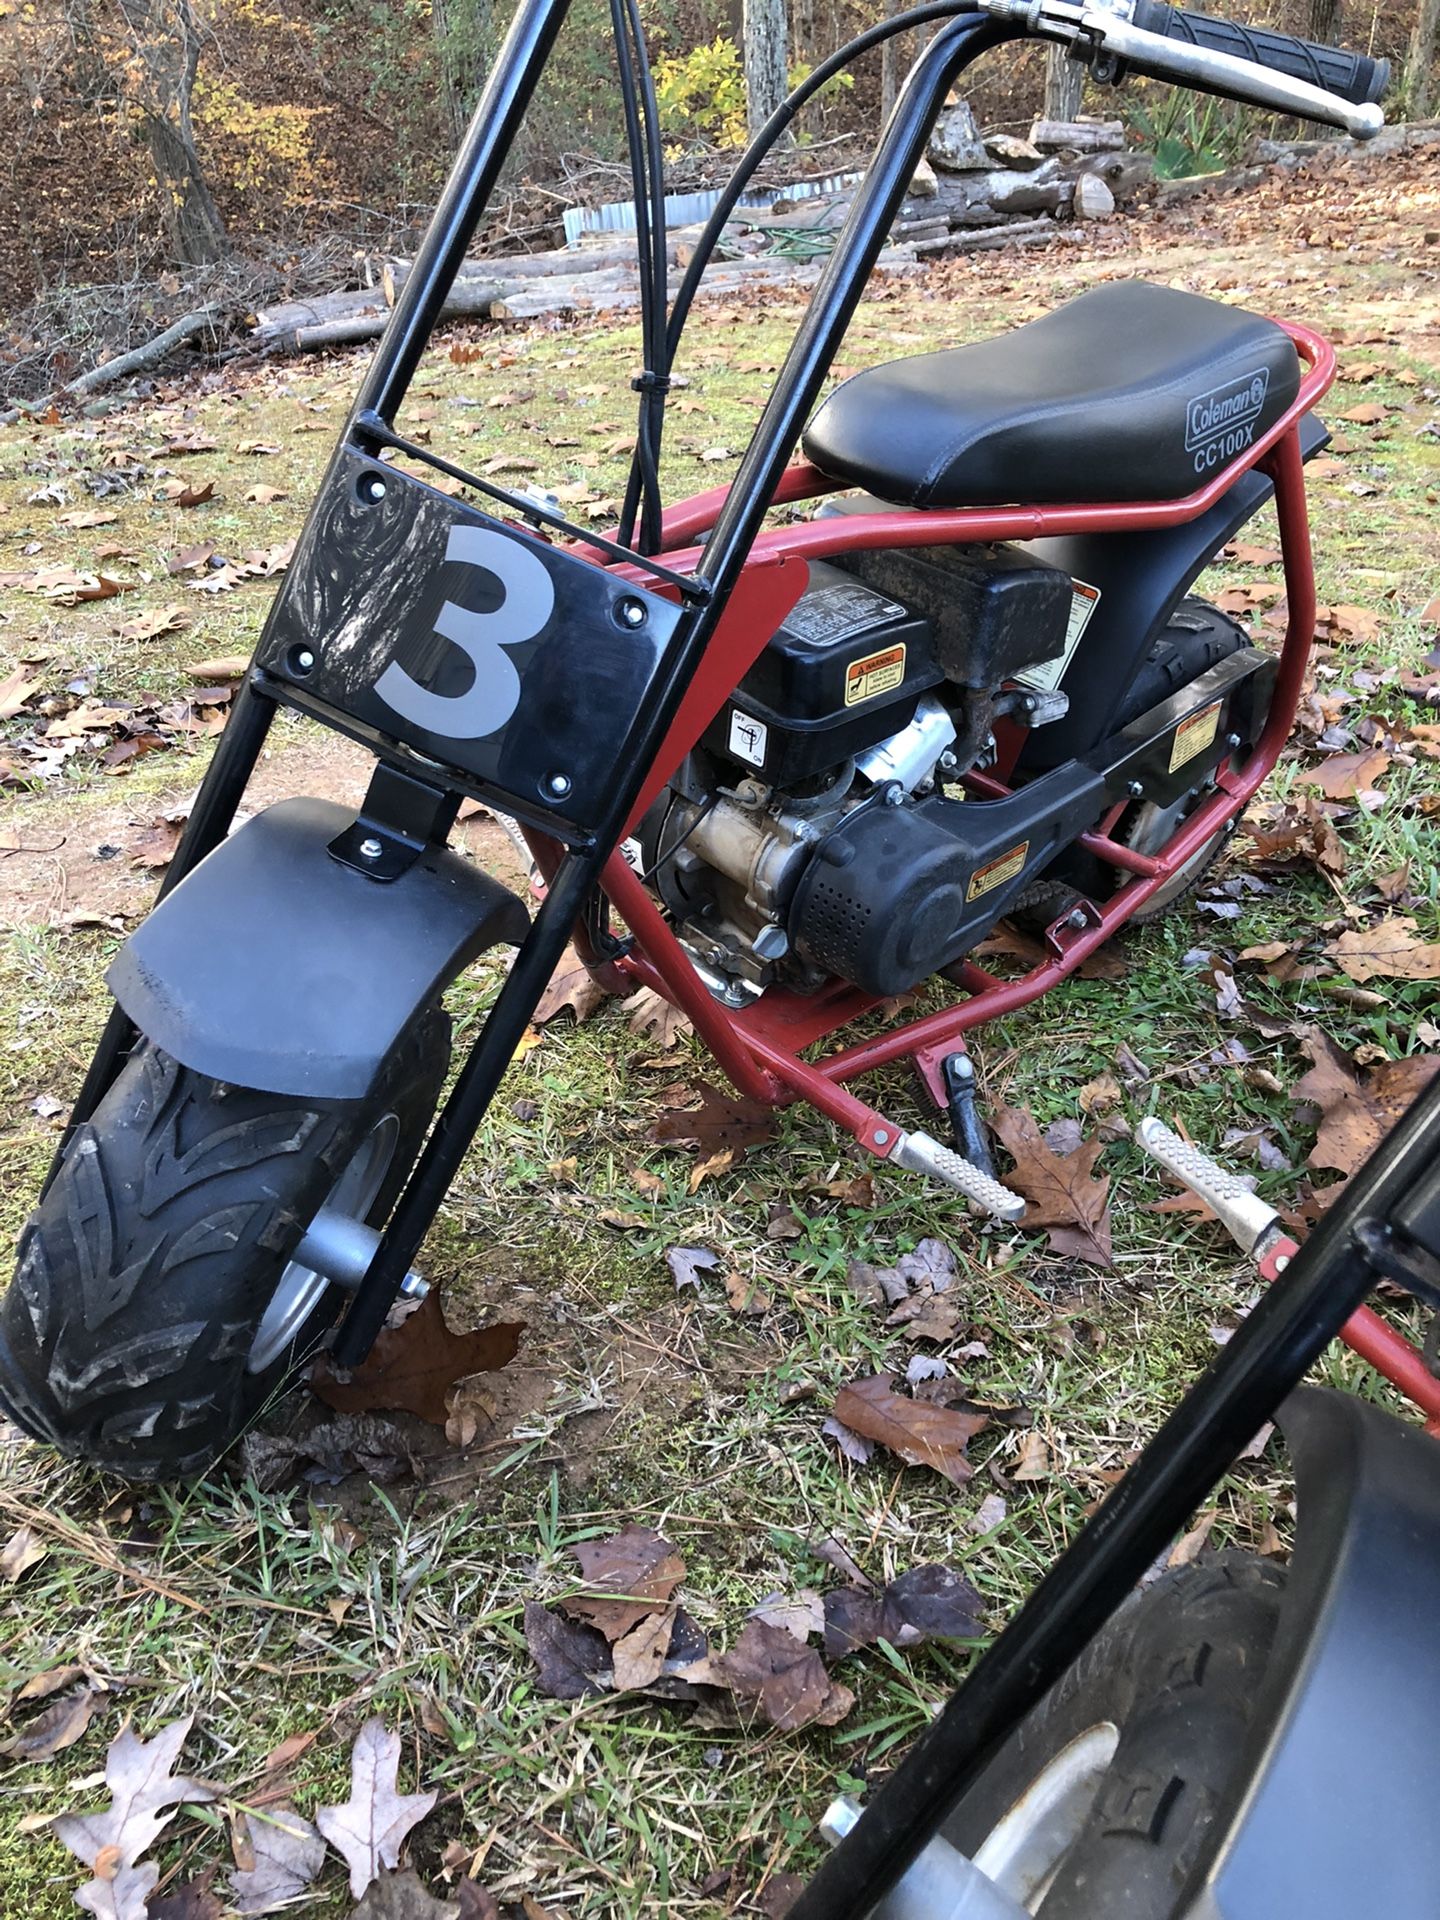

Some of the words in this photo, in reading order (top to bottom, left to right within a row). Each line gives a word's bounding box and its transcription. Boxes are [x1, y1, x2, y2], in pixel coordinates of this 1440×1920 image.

[1192, 390, 1250, 435] Coleman
[1194, 422, 1255, 473] CC100X
[374, 525, 555, 740] 3
[865, 653, 896, 671] WARNING
[734, 713, 745, 722] OFF
[753, 755, 762, 763] ON
